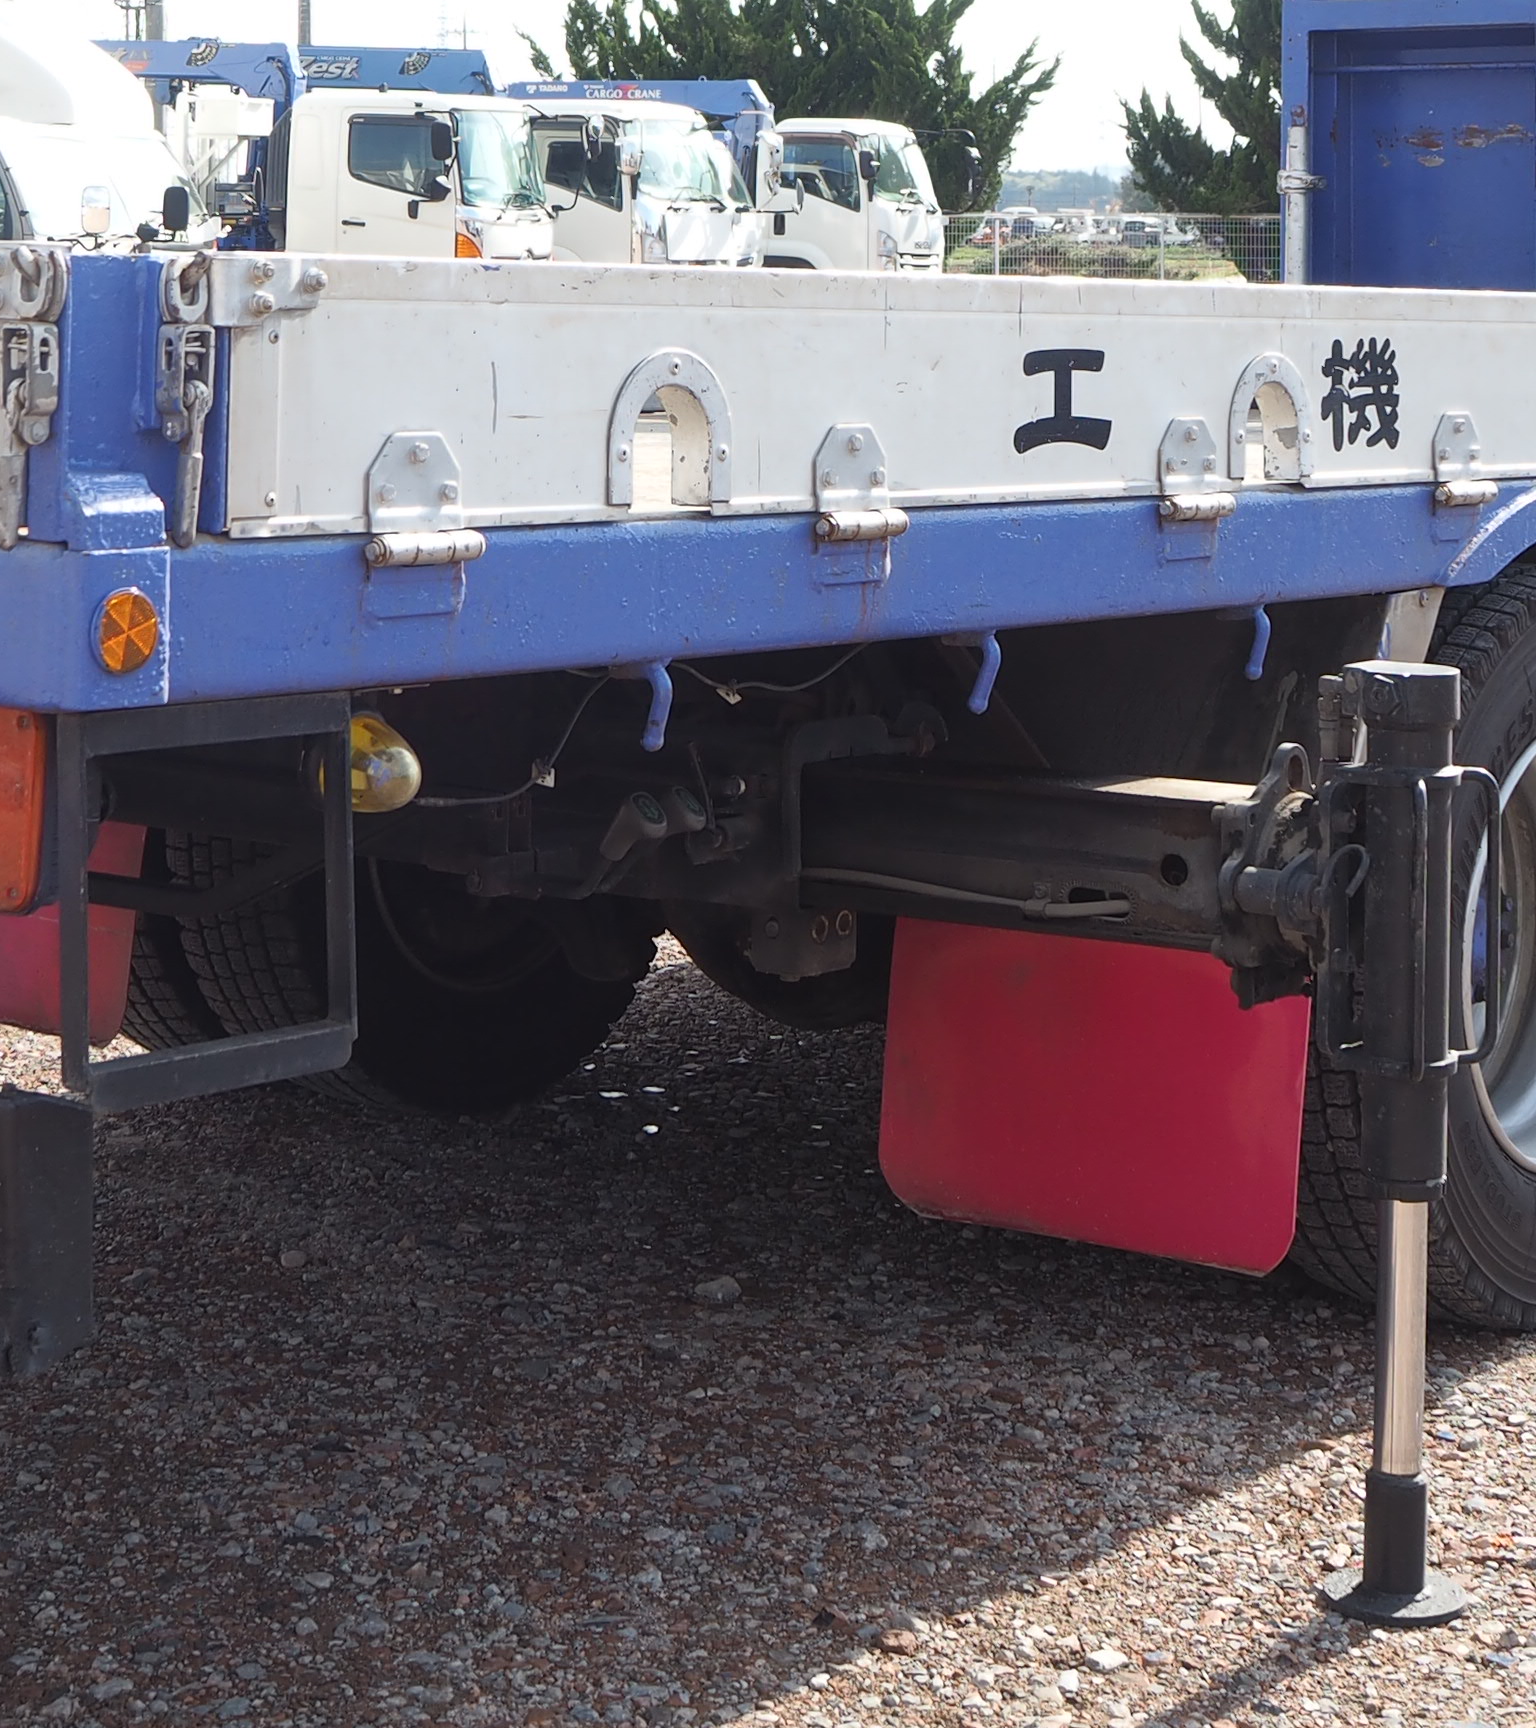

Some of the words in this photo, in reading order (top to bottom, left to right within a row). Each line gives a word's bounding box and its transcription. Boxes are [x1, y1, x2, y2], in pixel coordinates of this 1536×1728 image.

[538, 84, 569, 92] TADANO
[586, 88, 623, 99] CARGO
[627, 88, 662, 99] CRANE
